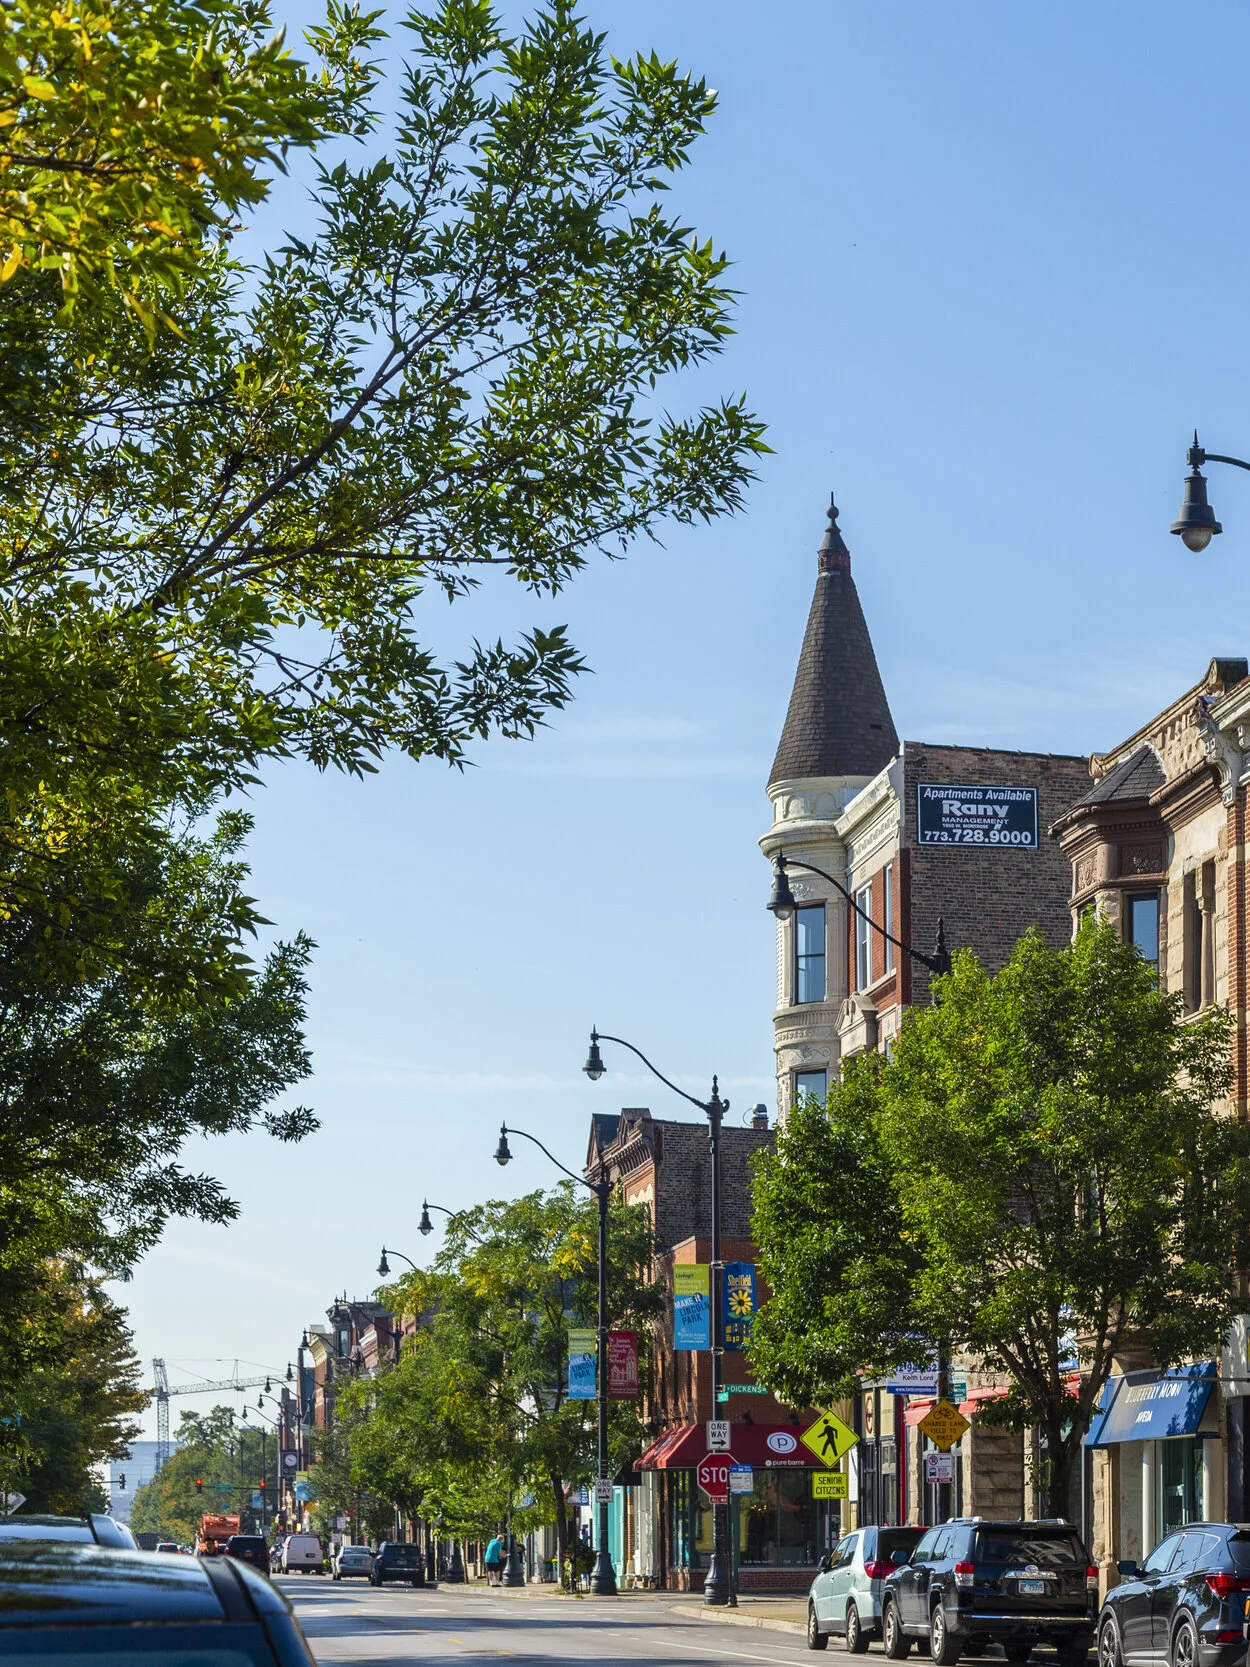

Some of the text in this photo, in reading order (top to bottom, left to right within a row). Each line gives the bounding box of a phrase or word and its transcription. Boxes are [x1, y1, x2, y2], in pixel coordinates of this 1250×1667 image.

[923, 787, 1032, 801] Apartments Available
[941, 799, 1010, 818] Rany
[941, 816, 1009, 825] MANAGEMENT
[924, 828, 1032, 844] 773.728.9000
[682, 1313, 703, 1326] PARK
[730, 1385, 762, 1393] DICKENS
[1160, 1382, 1182, 1399] MOON
[1135, 1410, 1153, 1424] AVEDA
[711, 1422, 727, 1431] ONE
[701, 1467, 728, 1483] STO
[818, 1477, 843, 1485] SENIOR
[815, 1486, 846, 1495] CITIZENS
